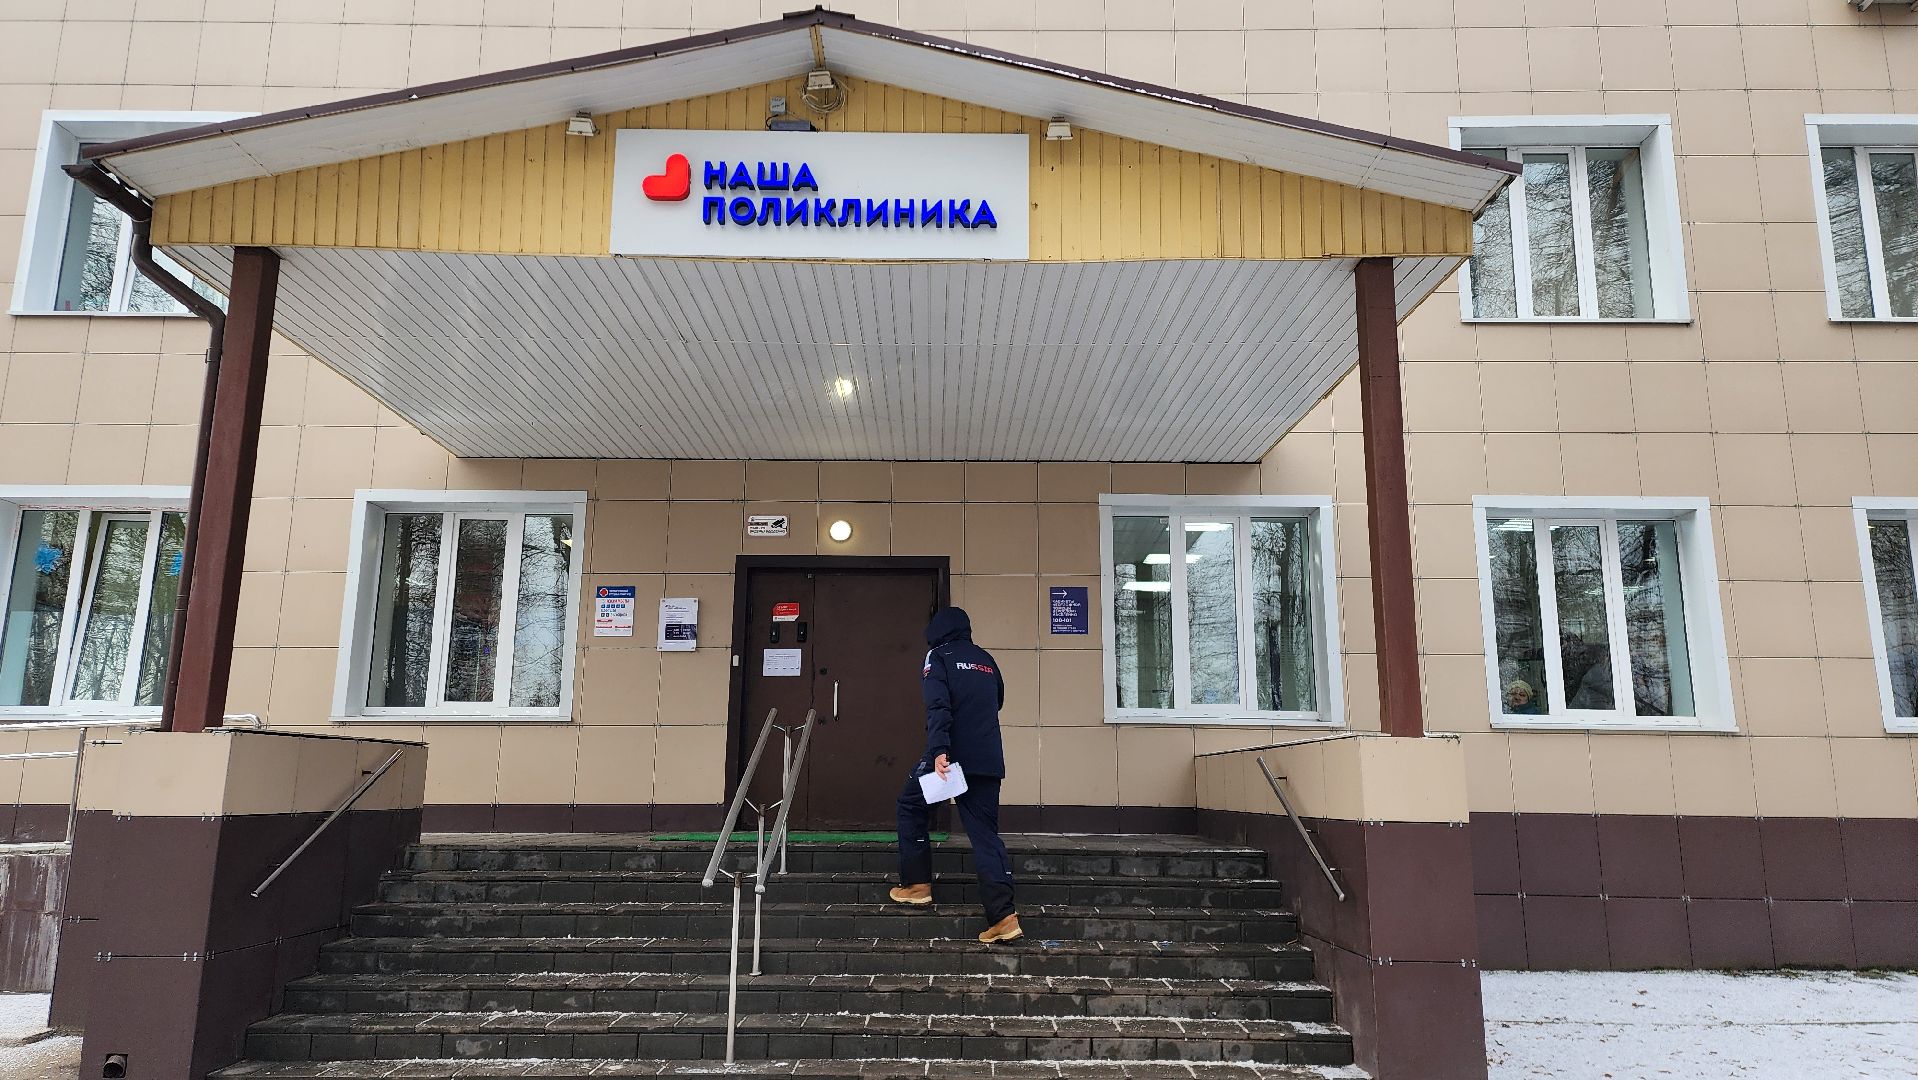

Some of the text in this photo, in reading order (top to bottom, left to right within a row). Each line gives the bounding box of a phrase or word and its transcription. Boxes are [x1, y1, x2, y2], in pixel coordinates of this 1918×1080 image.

[704, 161, 818, 191] НАША
[702, 197, 997, 228] ПОЛИКЛИНИКА
[956, 662, 993, 674] RUSSIA
